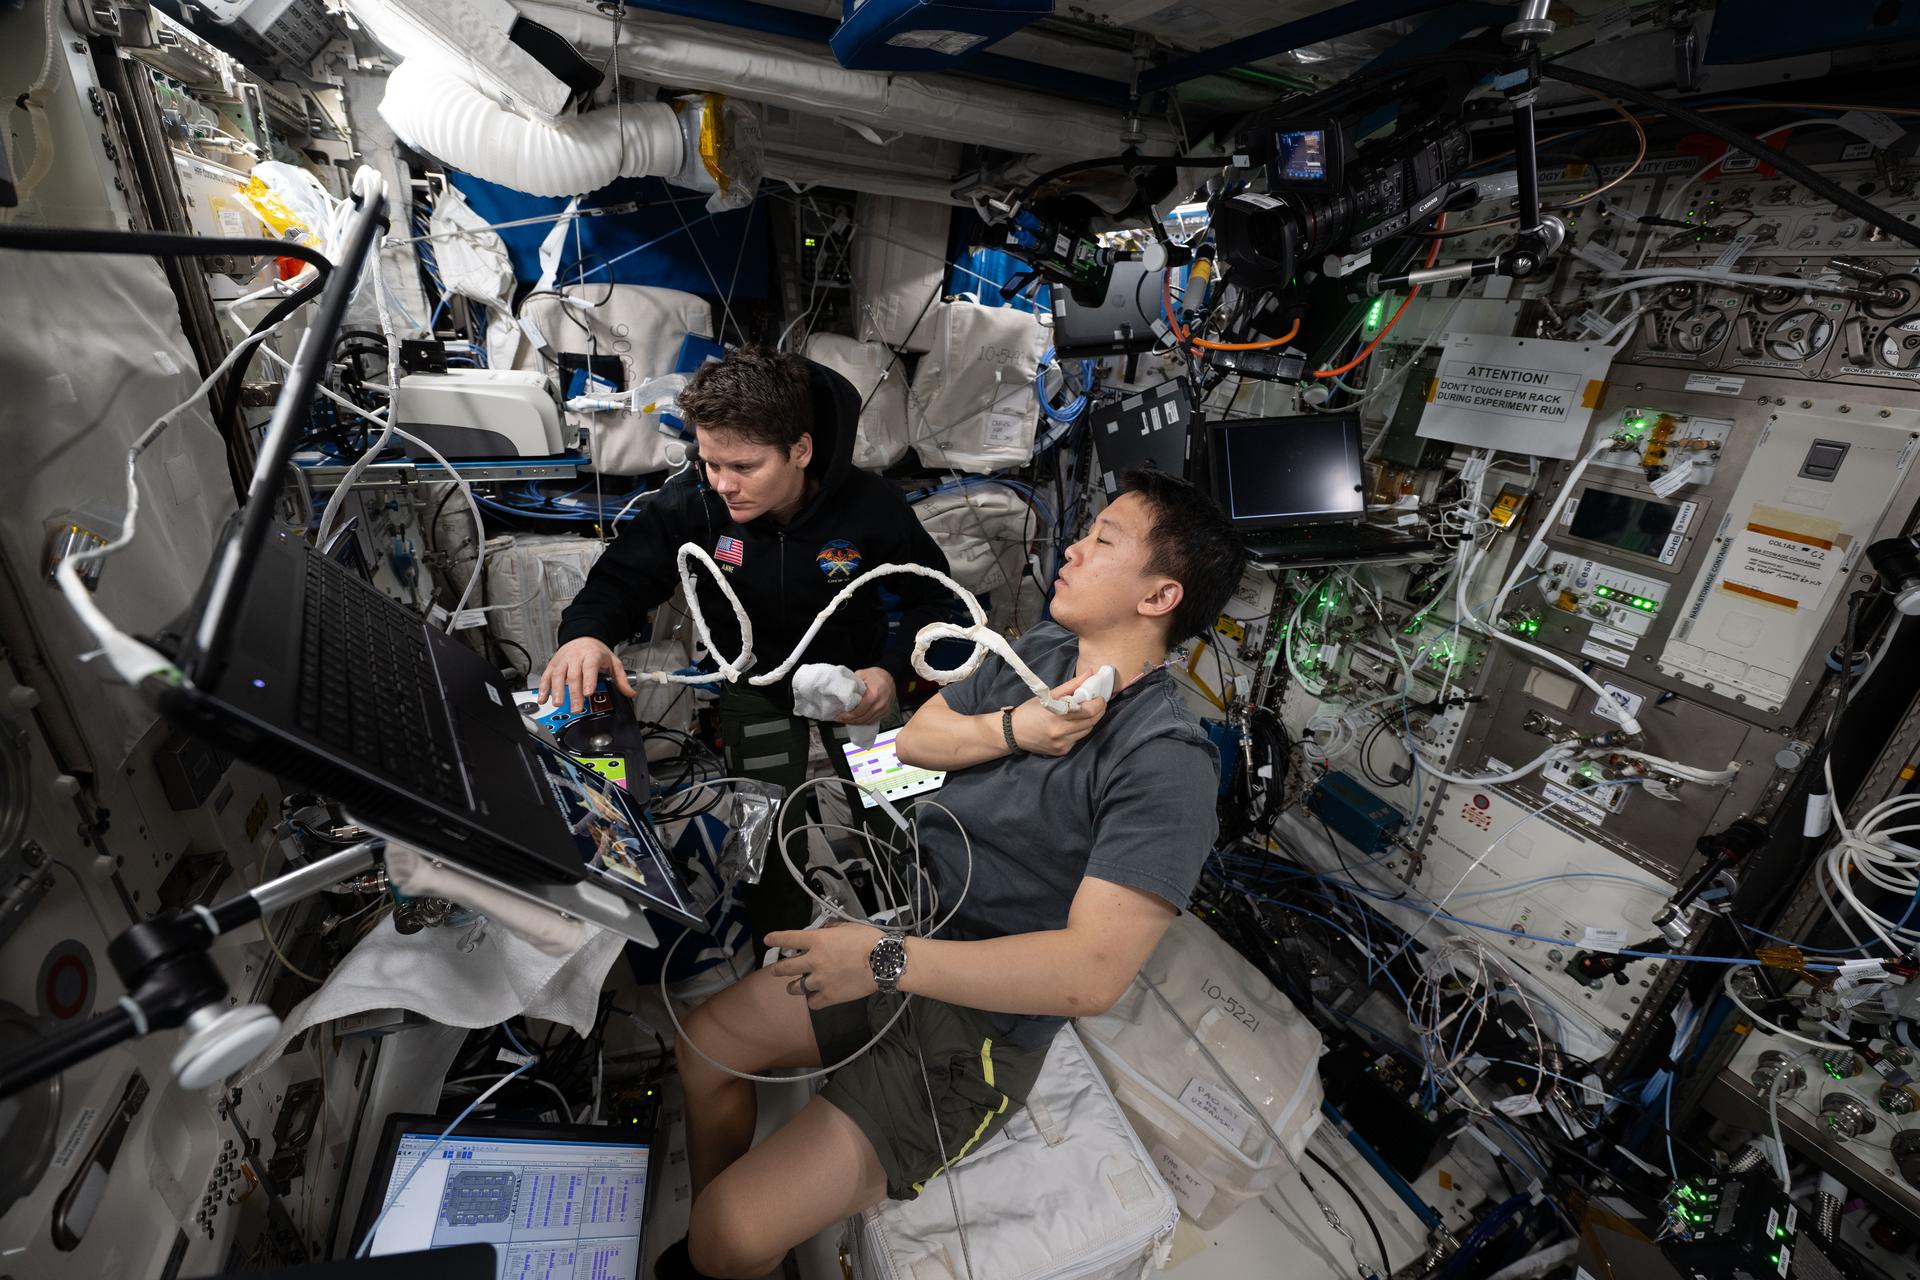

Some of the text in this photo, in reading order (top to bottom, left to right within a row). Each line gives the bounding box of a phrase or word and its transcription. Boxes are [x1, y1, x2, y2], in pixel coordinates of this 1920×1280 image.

[1418, 196, 1438, 213] Canon
[1467, 366, 1549, 385] ATTENTION!
[1437, 392, 1565, 416] DURING EXPERIMENT RUN
[1440, 381, 1562, 405] DON'T TOUCH EPM RACK
[1680, 503, 1692, 525] SINTEF
[1668, 535, 1681, 557] OHB
[1581, 561, 1593, 578] esa
[1689, 603, 1702, 619] NASA
[1698, 573, 1716, 603] STOWAGE
[1712, 537, 1732, 573] CONTAINER
